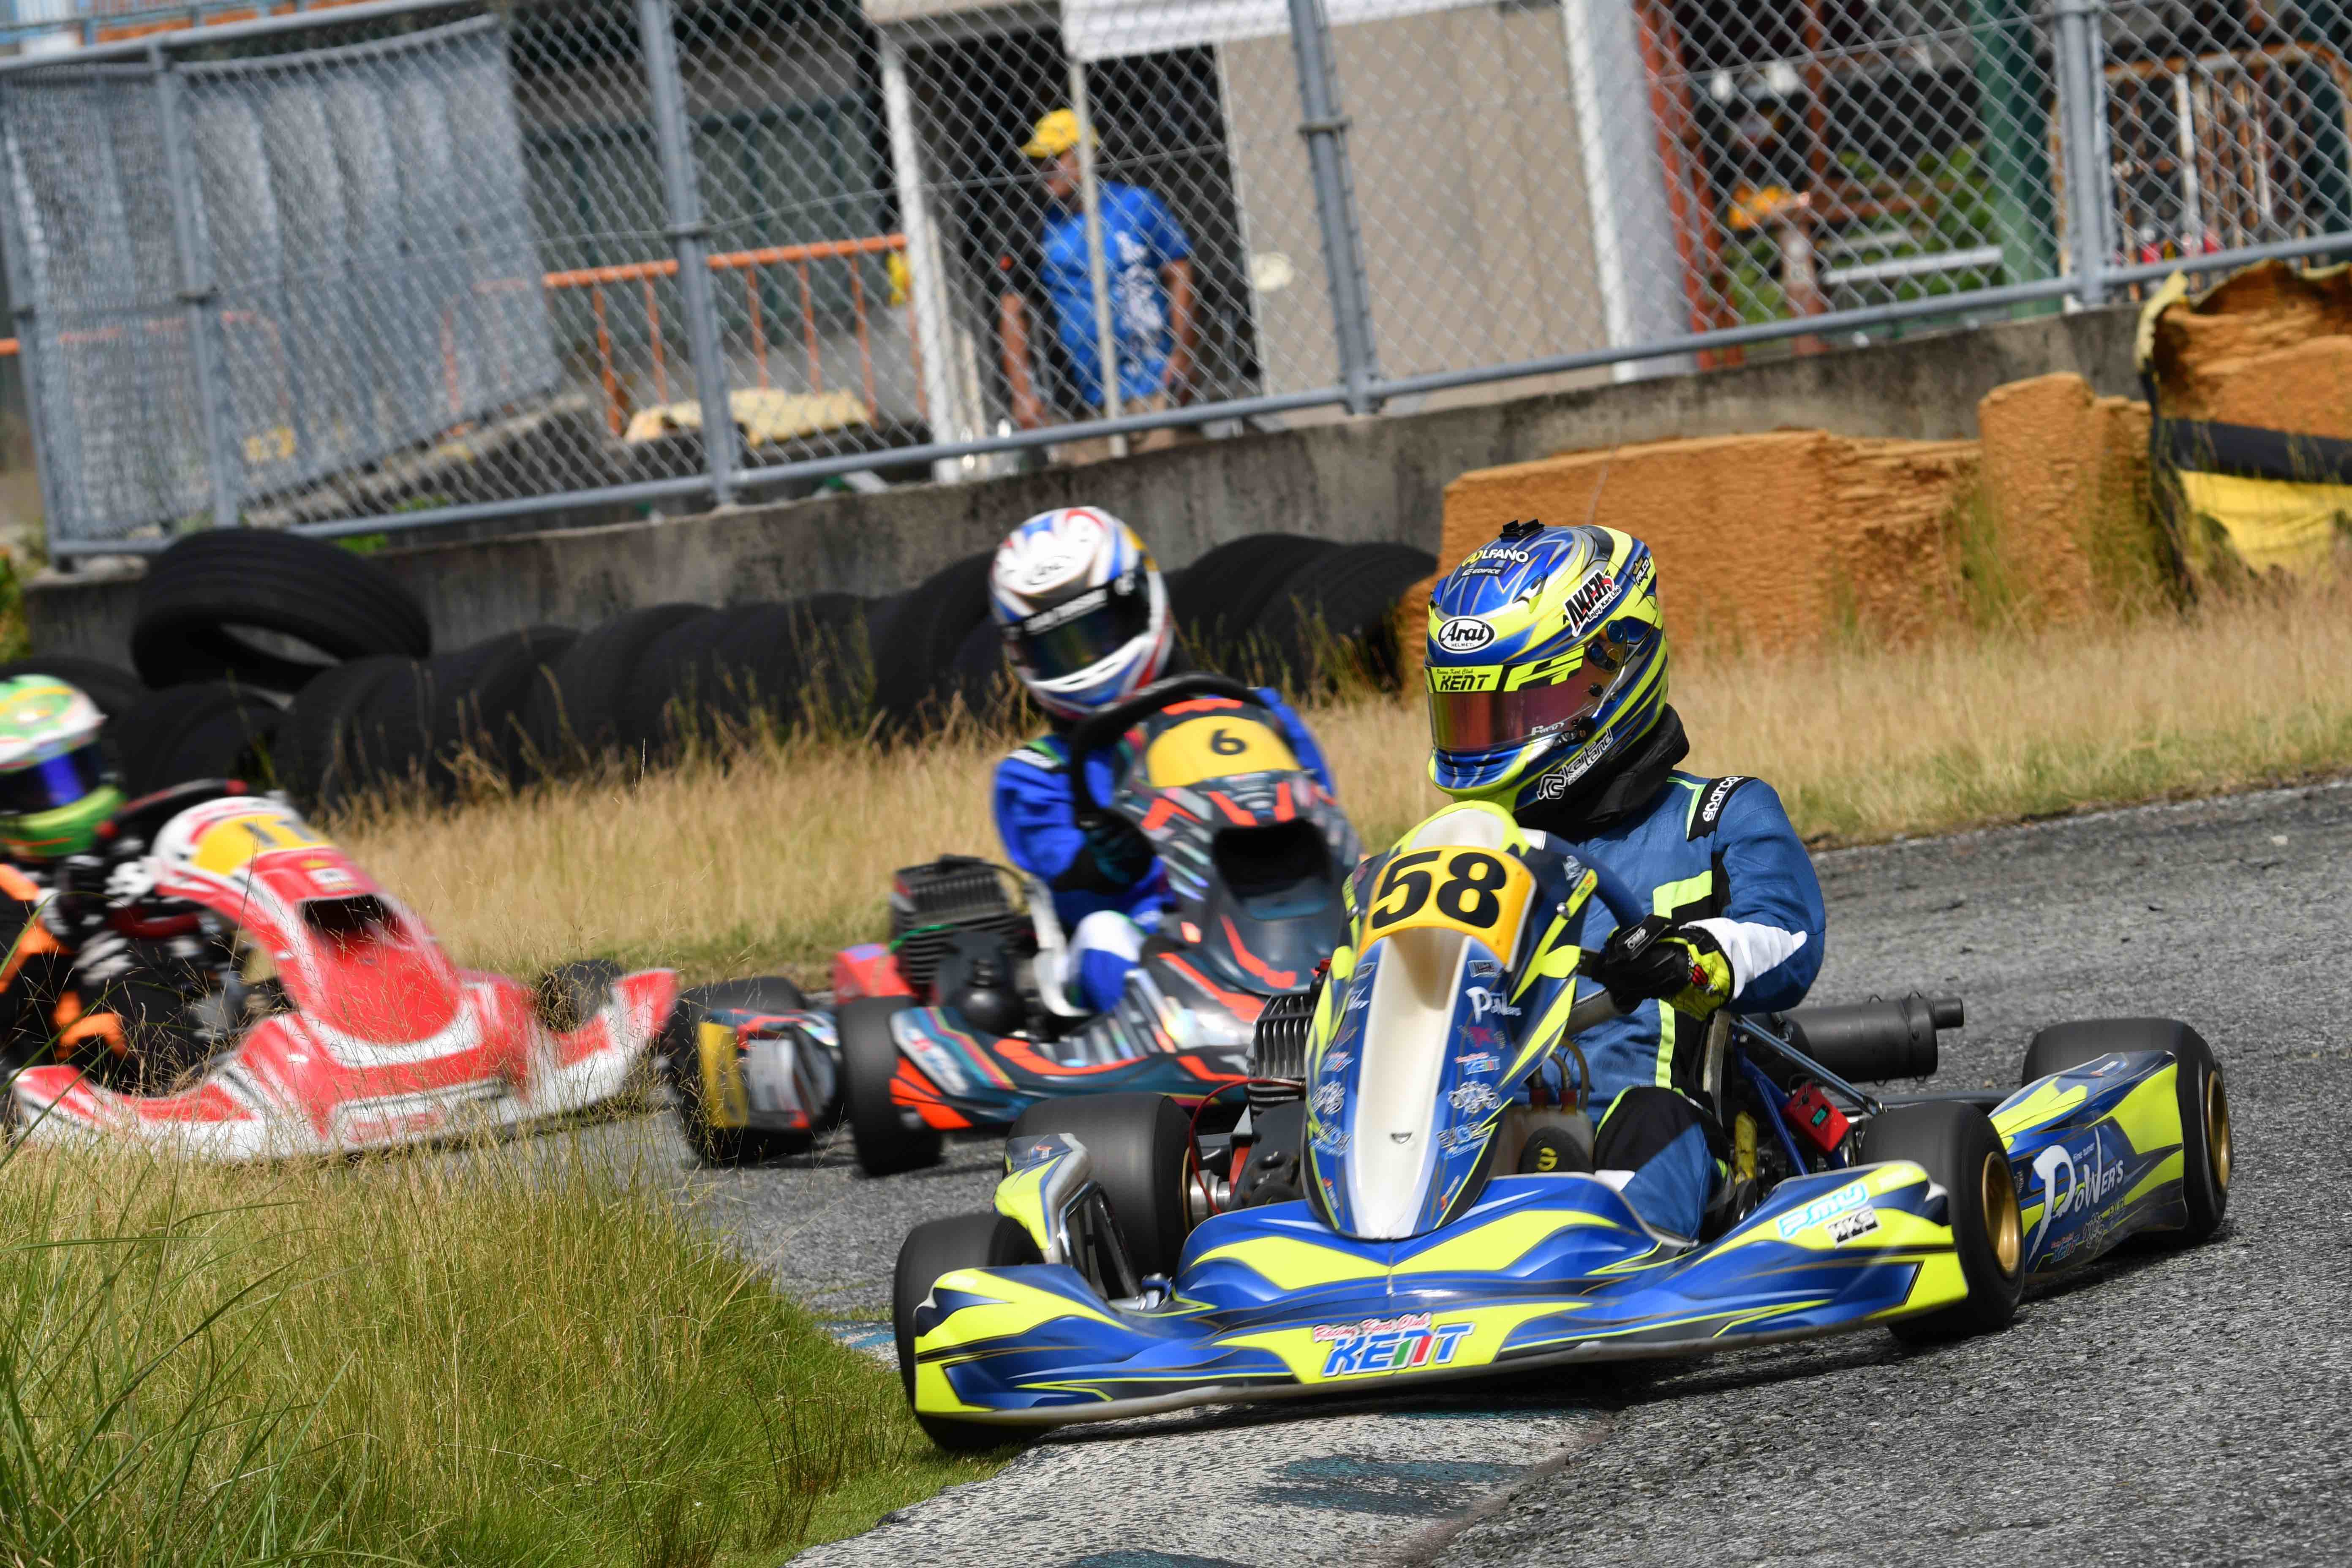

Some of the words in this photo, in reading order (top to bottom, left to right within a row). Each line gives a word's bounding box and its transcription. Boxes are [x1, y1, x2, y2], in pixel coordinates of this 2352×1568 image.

[1462, 549, 1529, 567] ALFANO
[1587, 606, 1602, 620] Enjoy
[1601, 596, 1612, 607] Kart
[1440, 622, 1487, 641] Arai
[1440, 674, 1491, 691] KENT
[1210, 728, 1247, 756] 6
[1703, 777, 1742, 822] sparco
[1372, 850, 1507, 929] 58
[1627, 928, 1647, 950] OMP
[1827, 1209, 1879, 1244] HKS
[1323, 1322, 1474, 1376] KENT
